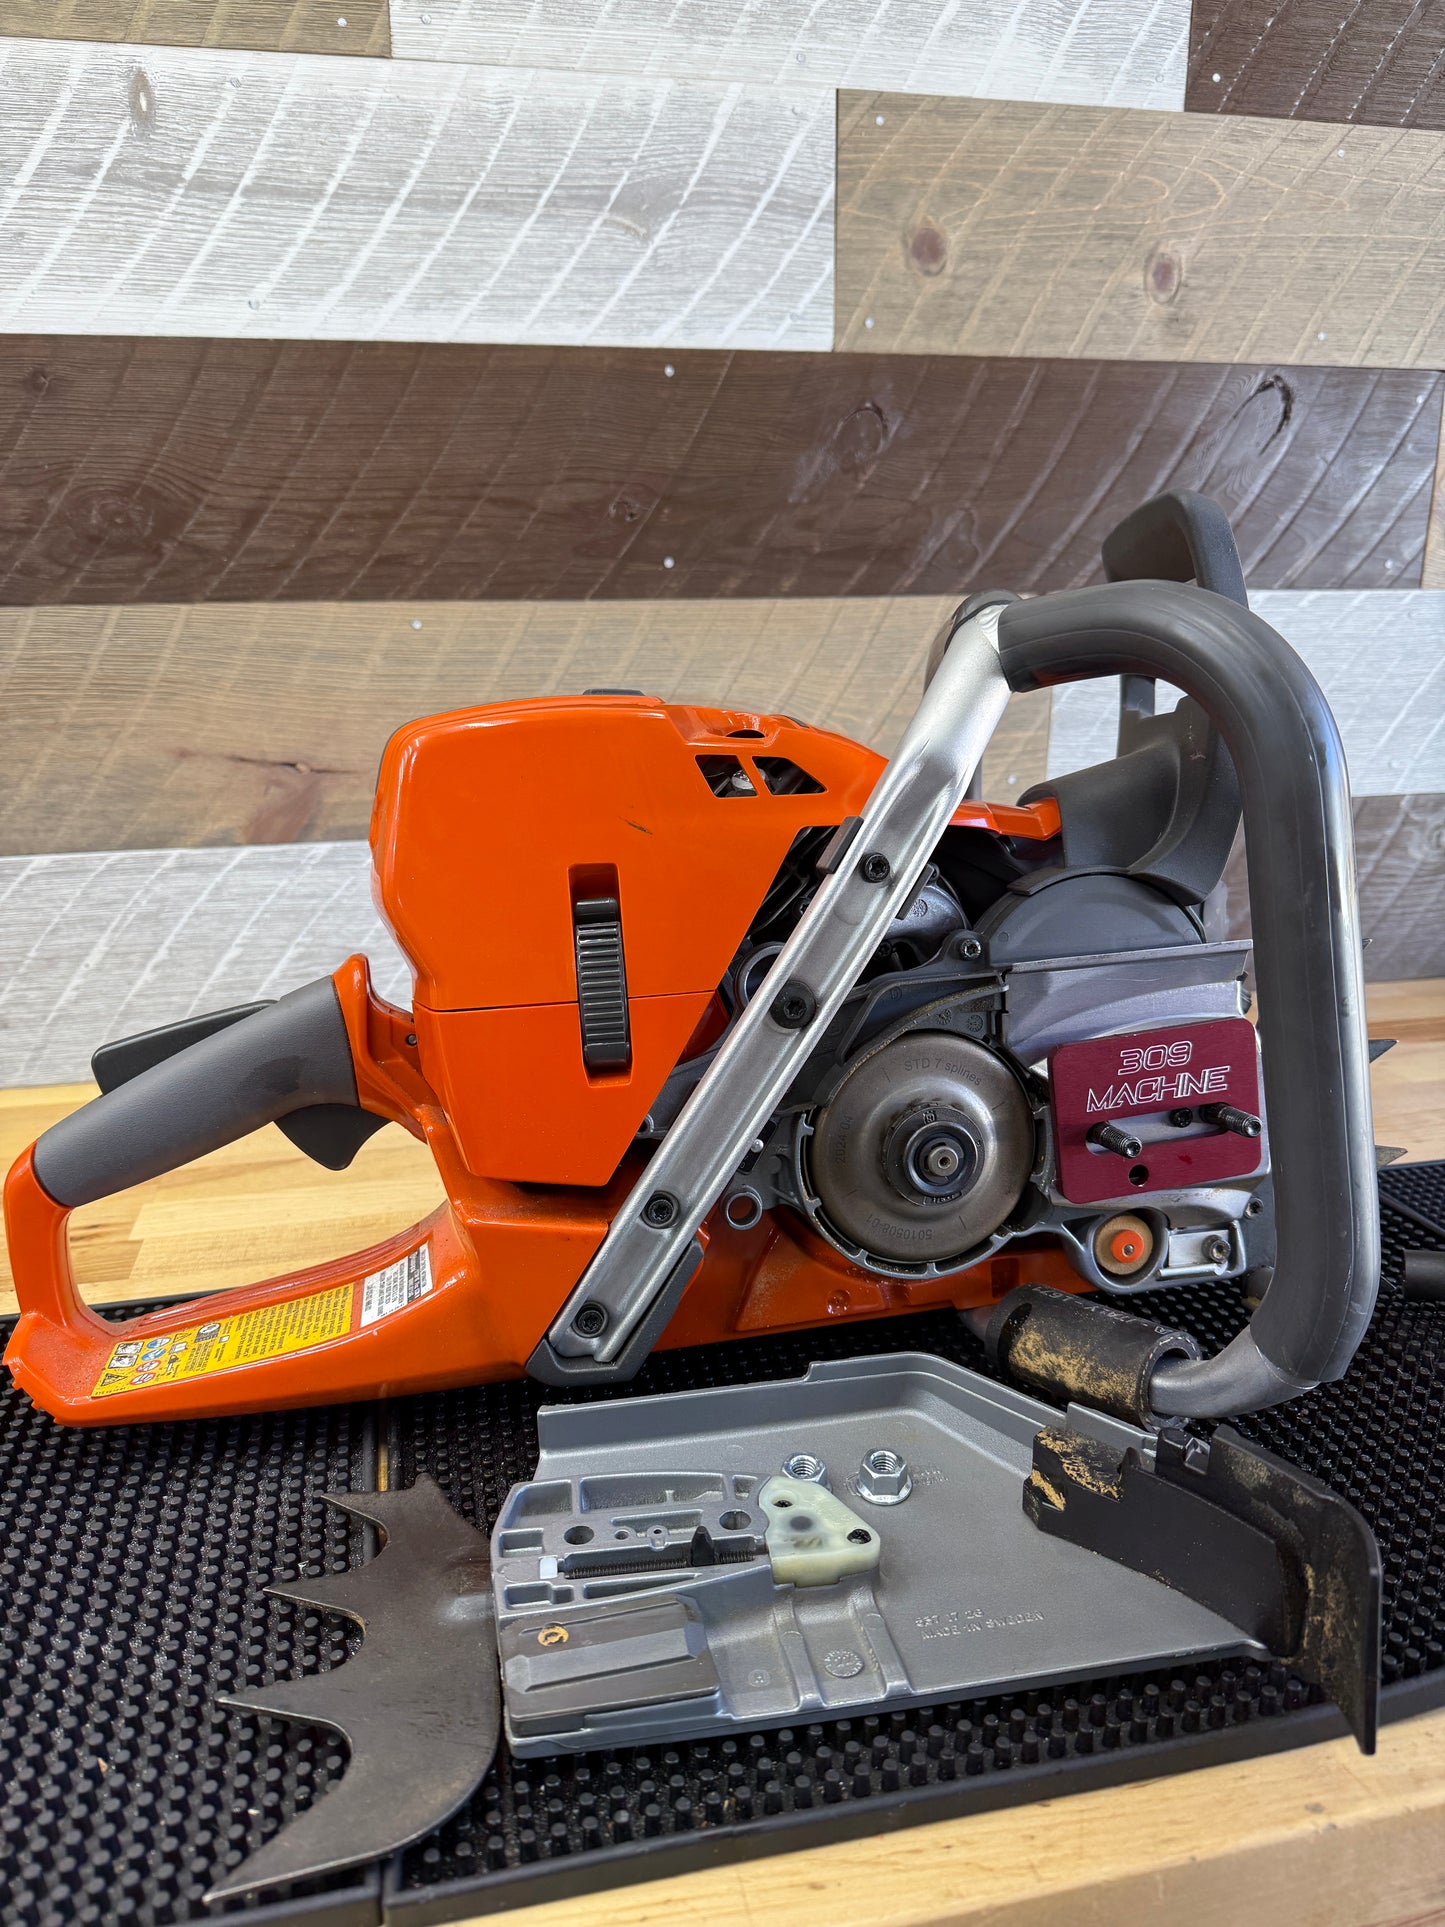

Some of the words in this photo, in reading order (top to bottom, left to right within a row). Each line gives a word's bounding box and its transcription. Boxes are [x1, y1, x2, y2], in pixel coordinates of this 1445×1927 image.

[904, 1058, 931, 1071] STD
[935, 1058, 943, 1068] 7
[945, 1062, 982, 1086] splines
[1118, 1041, 1193, 1076] 309
[1086, 1065, 1231, 1113] MACHINE
[921, 1624, 962, 1640] MADE
[985, 1610, 1045, 1629] SWEDEN
